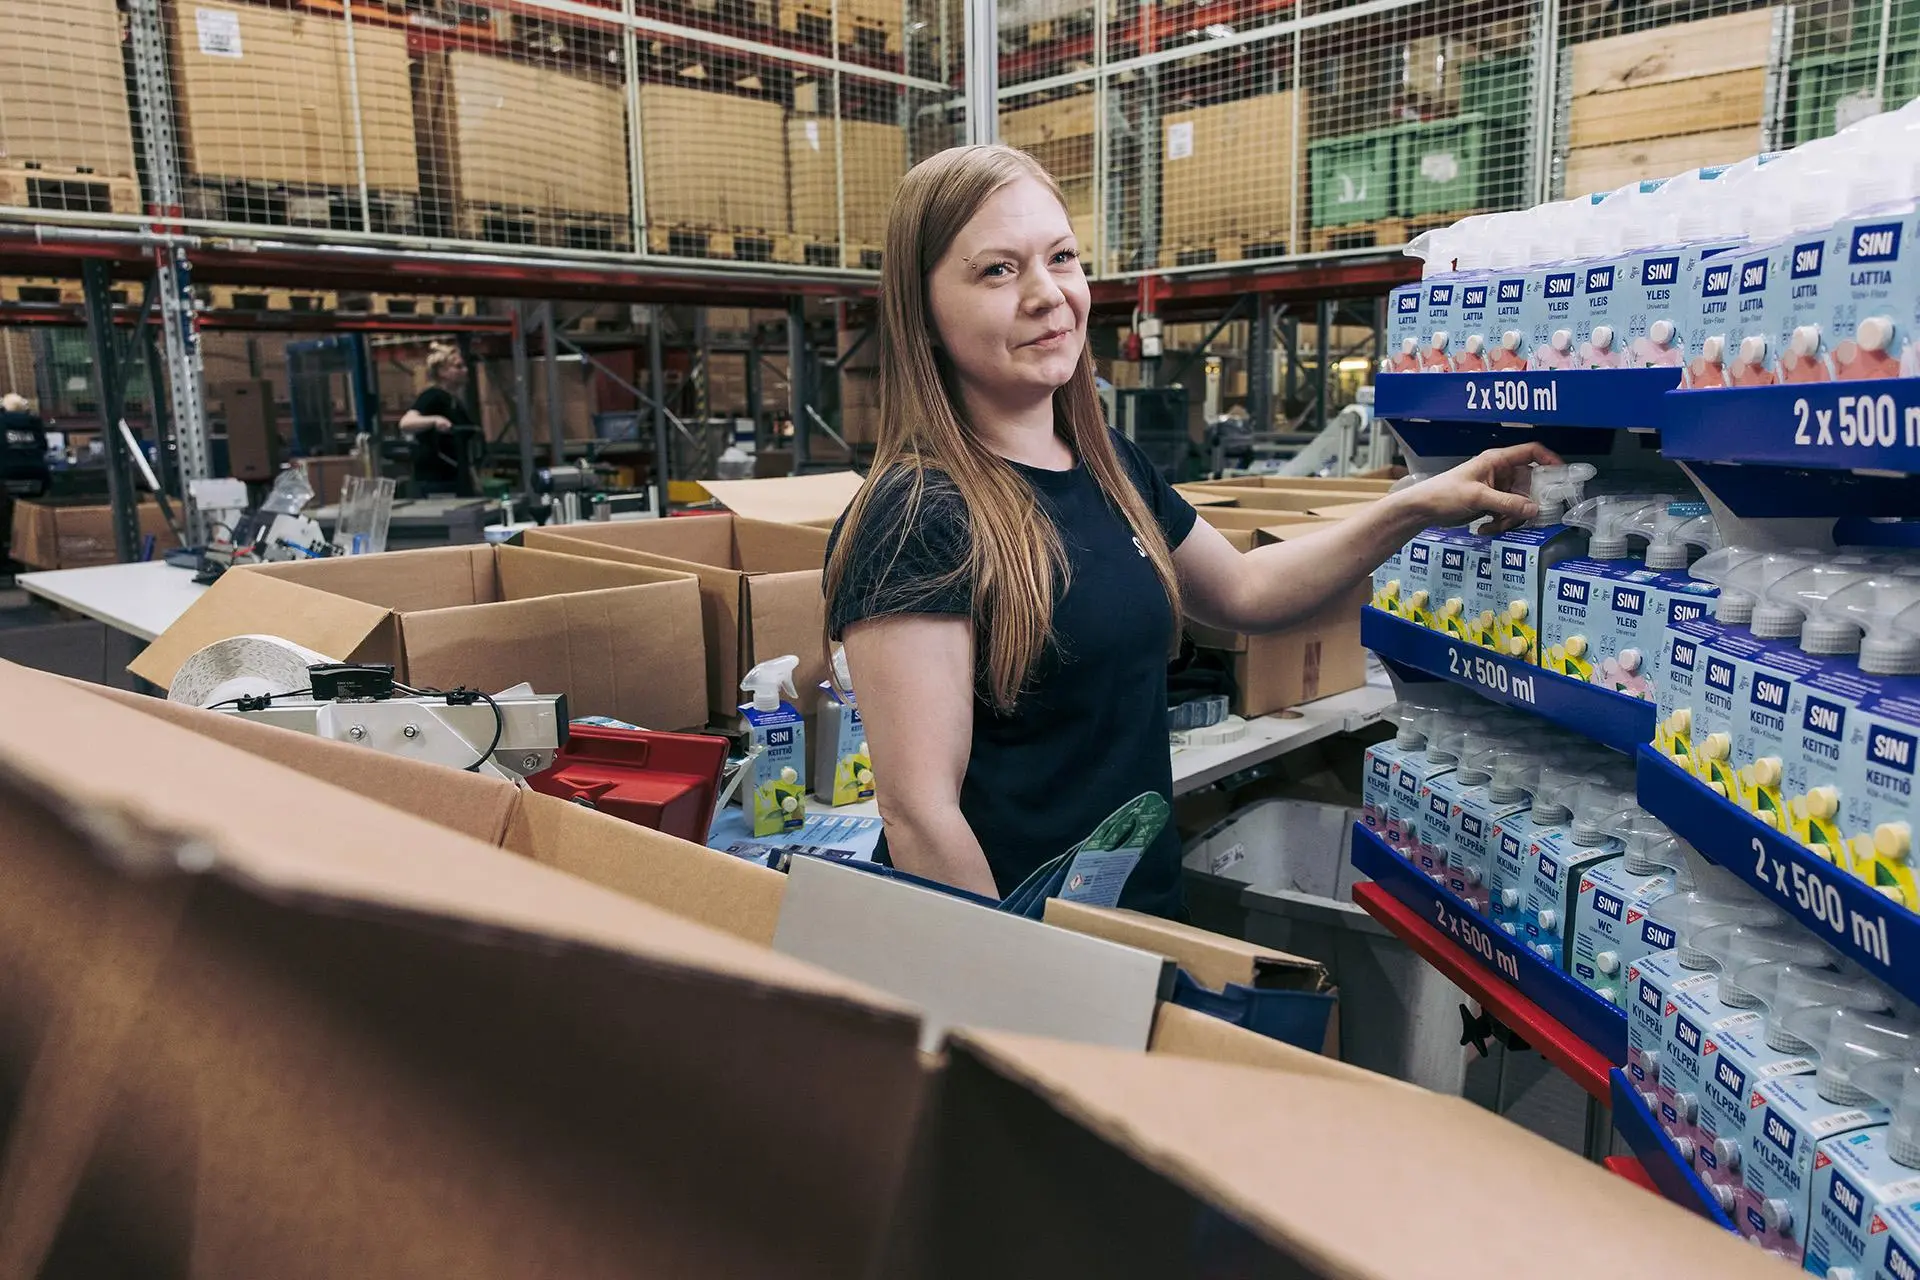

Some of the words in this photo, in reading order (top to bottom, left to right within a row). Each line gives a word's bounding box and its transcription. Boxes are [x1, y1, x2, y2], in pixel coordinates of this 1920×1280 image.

[1857, 230, 1893, 257] SINI
[1795, 249, 1819, 272] SINI
[1590, 272, 1609, 288] SINI
[1648, 263, 1672, 280] SINI
[1744, 266, 1763, 287] SINI
[1850, 270, 1892, 286] LATTIA
[1549, 279, 1571, 293] SINI
[1707, 272, 1730, 291] SINI
[1432, 287, 1449, 301] SINI
[1466, 291, 1483, 304] SINI
[1501, 285, 1519, 298] SINI
[1647, 290, 1670, 300] YLEIS
[1792, 284, 1817, 299] LATTIA
[1401, 297, 1416, 309] SINI
[1548, 302, 1569, 311] YLEIS
[1589, 296, 1608, 307] YLEIS
[1702, 302, 1727, 314] LATTIA
[1739, 299, 1763, 312] LATTIA
[1463, 312, 1483, 320] LATTIA
[1498, 307, 1519, 315] LATTIA
[1399, 316, 1416, 324] LATTIA
[1466, 381, 1478, 410] 2
[1480, 389, 1492, 410] x
[1495, 381, 1530, 411] 500
[1533, 380, 1557, 411] ml
[1793, 398, 1812, 445] 2
[1816, 409, 1834, 445] x
[1838, 394, 1897, 447] 500
[1413, 547, 1427, 561] SINI
[1445, 553, 1461, 567] SINI
[1505, 552, 1522, 567] SINI
[1410, 566, 1428, 575] KEITTIÖ
[1442, 572, 1463, 582] KEITTIÖ
[1503, 573, 1525, 584] KEITTIÖ
[1563, 583, 1584, 600] SINI
[1617, 592, 1639, 610] SINI
[1558, 604, 1586, 618] KEITTIÖ
[1674, 605, 1700, 621] SINI
[1616, 616, 1637, 629] YLEIS
[1675, 644, 1693, 666] SINI
[1448, 647, 1459, 675] 2
[1462, 658, 1473, 680] x
[1475, 656, 1508, 693] 500
[1512, 675, 1535, 704] ml
[1710, 664, 1731, 687] SINI
[1705, 690, 1732, 711] KEITTIÖ
[1757, 681, 1783, 706] SINI
[1750, 709, 1784, 732] KEITTIÖ
[1809, 705, 1839, 733] SINI
[771, 731, 789, 743] SINI
[768, 746, 792, 757] KEITTIÖ
[1802, 736, 1839, 761] KEITTIÖ
[1873, 734, 1909, 766] SINI
[1375, 762, 1389, 776] SINI
[1402, 775, 1414, 789] SINI
[1866, 768, 1911, 796] KEITTIÖ
[1393, 788, 1419, 808] KYLPPÄRI
[1433, 799, 1446, 814] SINI
[1425, 813, 1450, 834] KYLPPÄR
[1464, 818, 1479, 834] SINI
[1455, 832, 1486, 856] KYLPPÄRI
[1503, 838, 1516, 855] SINI
[1497, 855, 1521, 877] IKKUNAT
[1541, 860, 1555, 878] SINI
[1534, 875, 1559, 901] IKKUNAT
[1598, 896, 1618, 916] SINI
[1752, 838, 1770, 883] 2
[1772, 858, 1790, 898] x
[1791, 861, 1845, 934] 500
[1851, 910, 1891, 967] ml
[1598, 919, 1612, 934] WC
[1436, 900, 1447, 927] 2
[1449, 914, 1460, 937] x
[1461, 917, 1492, 960] 500
[1496, 949, 1519, 980] ml
[1647, 927, 1670, 947] SINI
[1642, 986, 1658, 1009] SINI
[1679, 1022, 1697, 1048] SINI
[1720, 1063, 1740, 1092] SINI
[1705, 1080, 1746, 1128] KYLPPÄR
[1768, 1117, 1791, 1149] SINI
[1753, 1135, 1800, 1190] KYLPPÄRI
[1834, 1180, 1858, 1216] SINI
[1822, 1200, 1866, 1257] IKKUNAT
